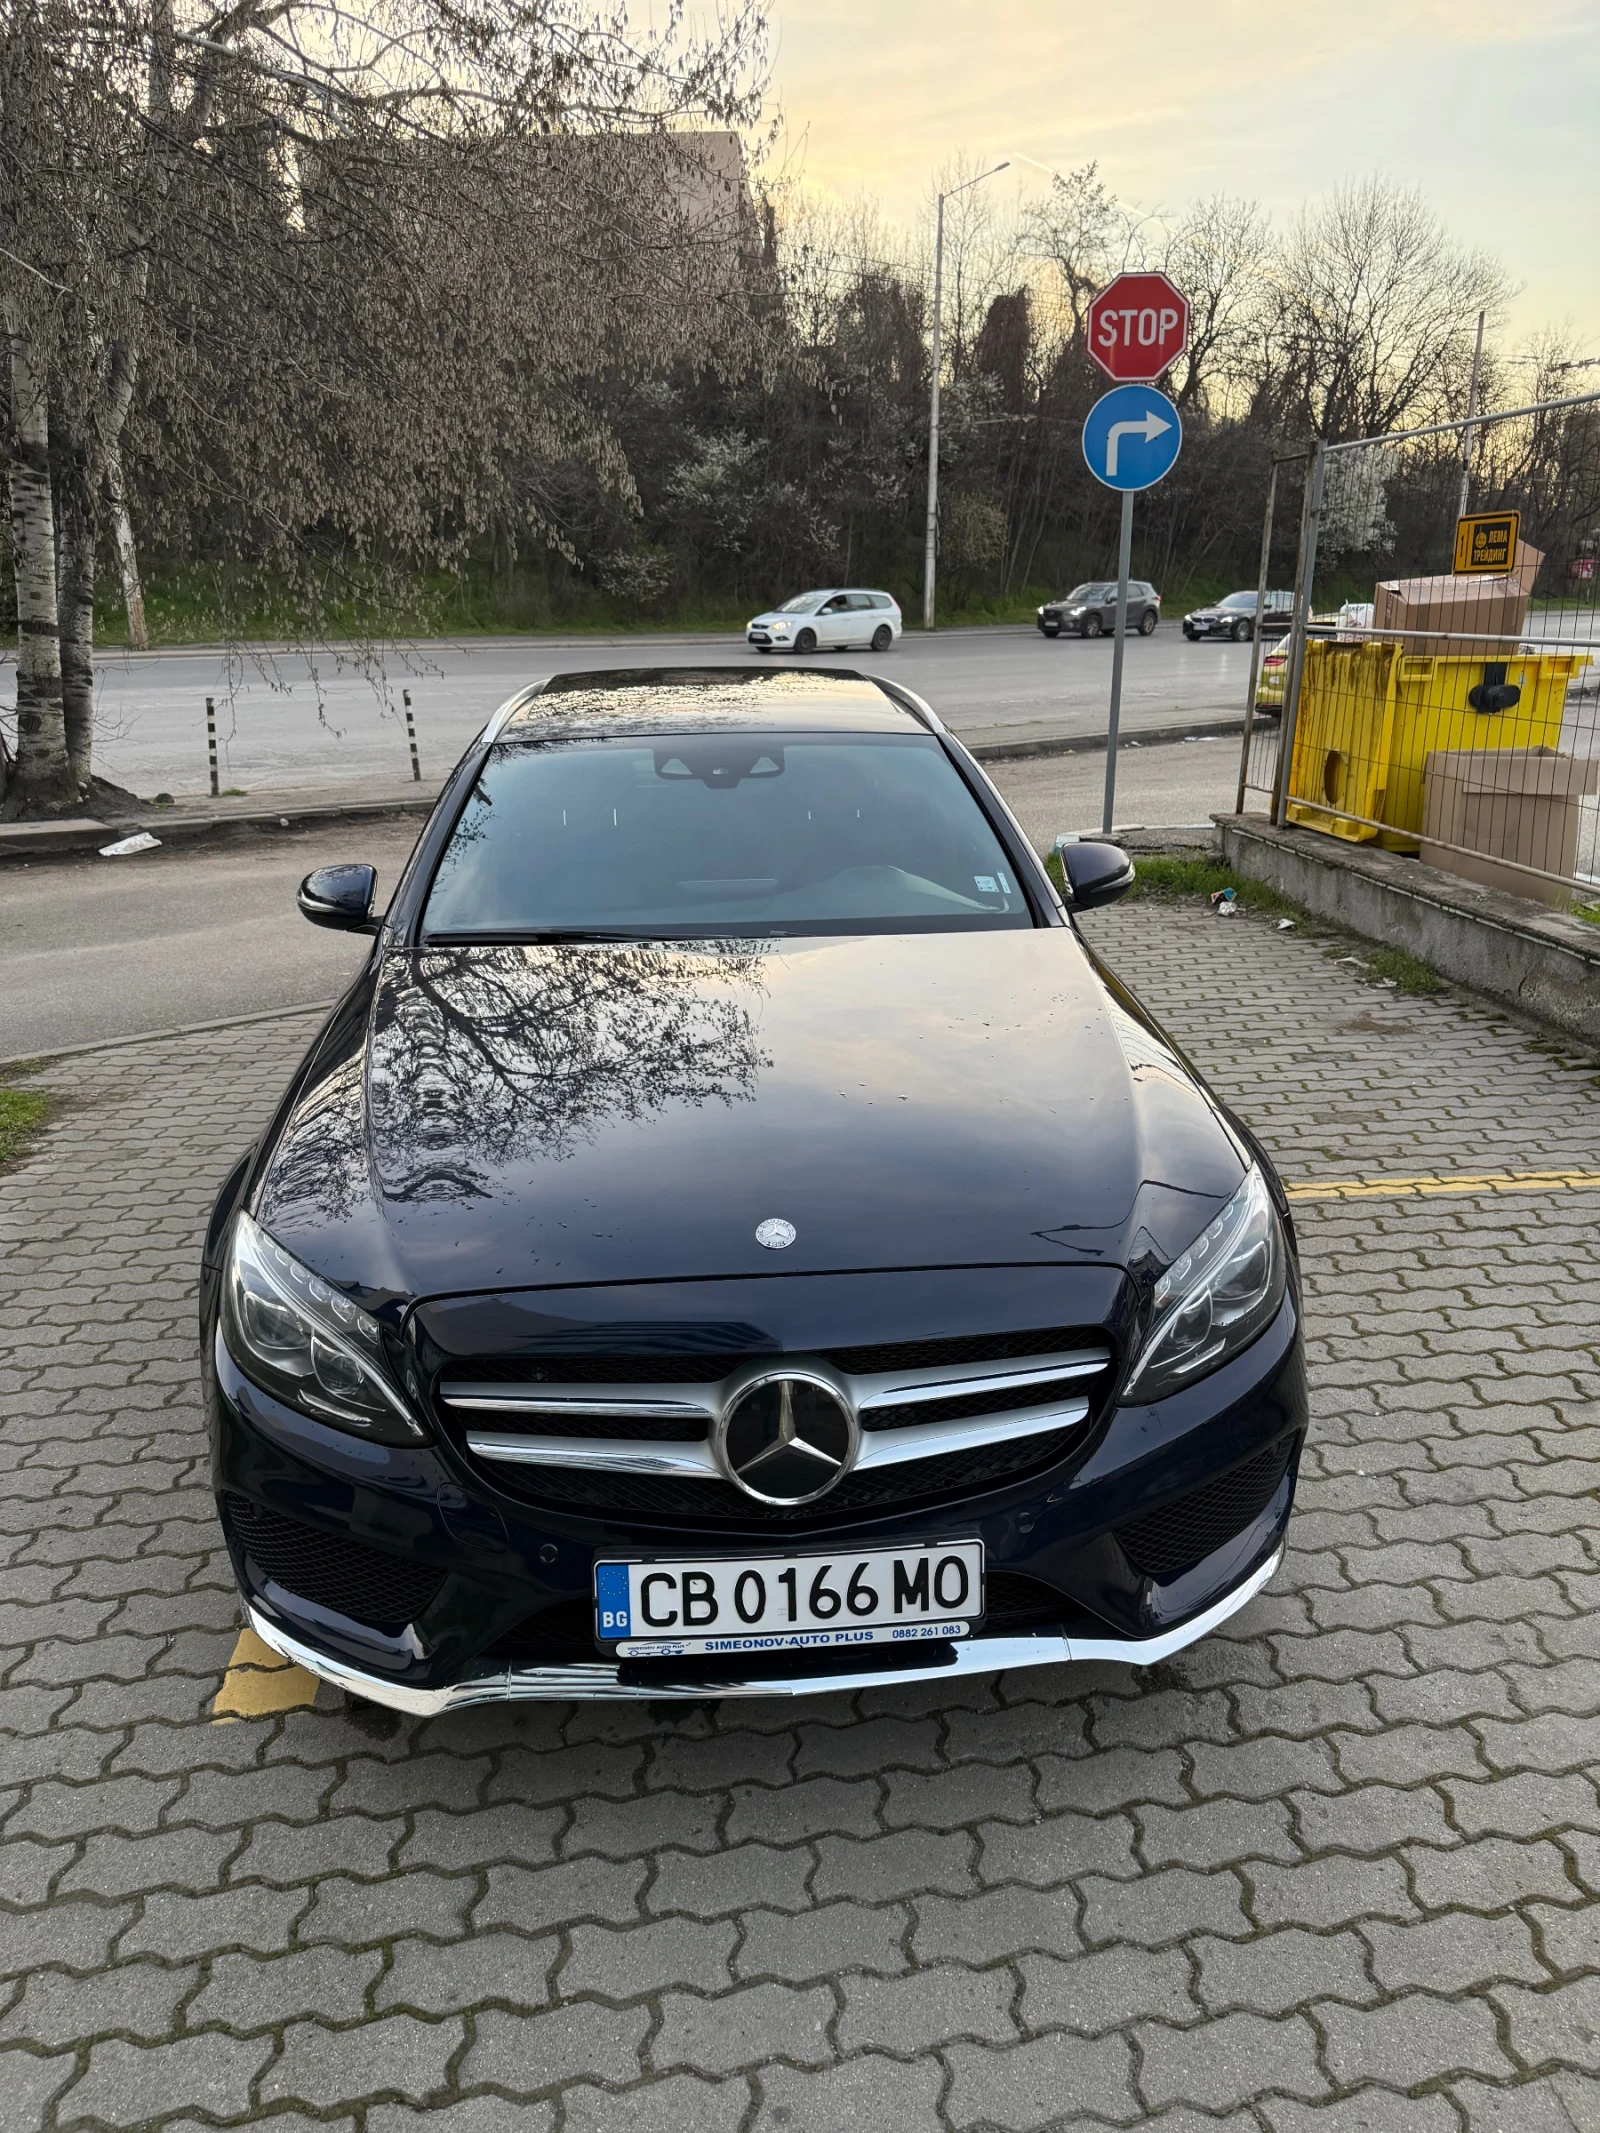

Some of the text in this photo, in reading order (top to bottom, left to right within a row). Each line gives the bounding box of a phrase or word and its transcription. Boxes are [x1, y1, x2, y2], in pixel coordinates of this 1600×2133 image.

[1098, 307, 1178, 347] STOP
[1488, 529, 1508, 543] ЛЕМА
[1473, 546, 1507, 563] ТРЕЙДИНГ
[641, 1555, 969, 1628] CB 0166 MO
[602, 1611, 628, 1629] BG
[835, 1631, 874, 1643] PLUS
[892, 1625, 961, 1639] 0882 261 083
